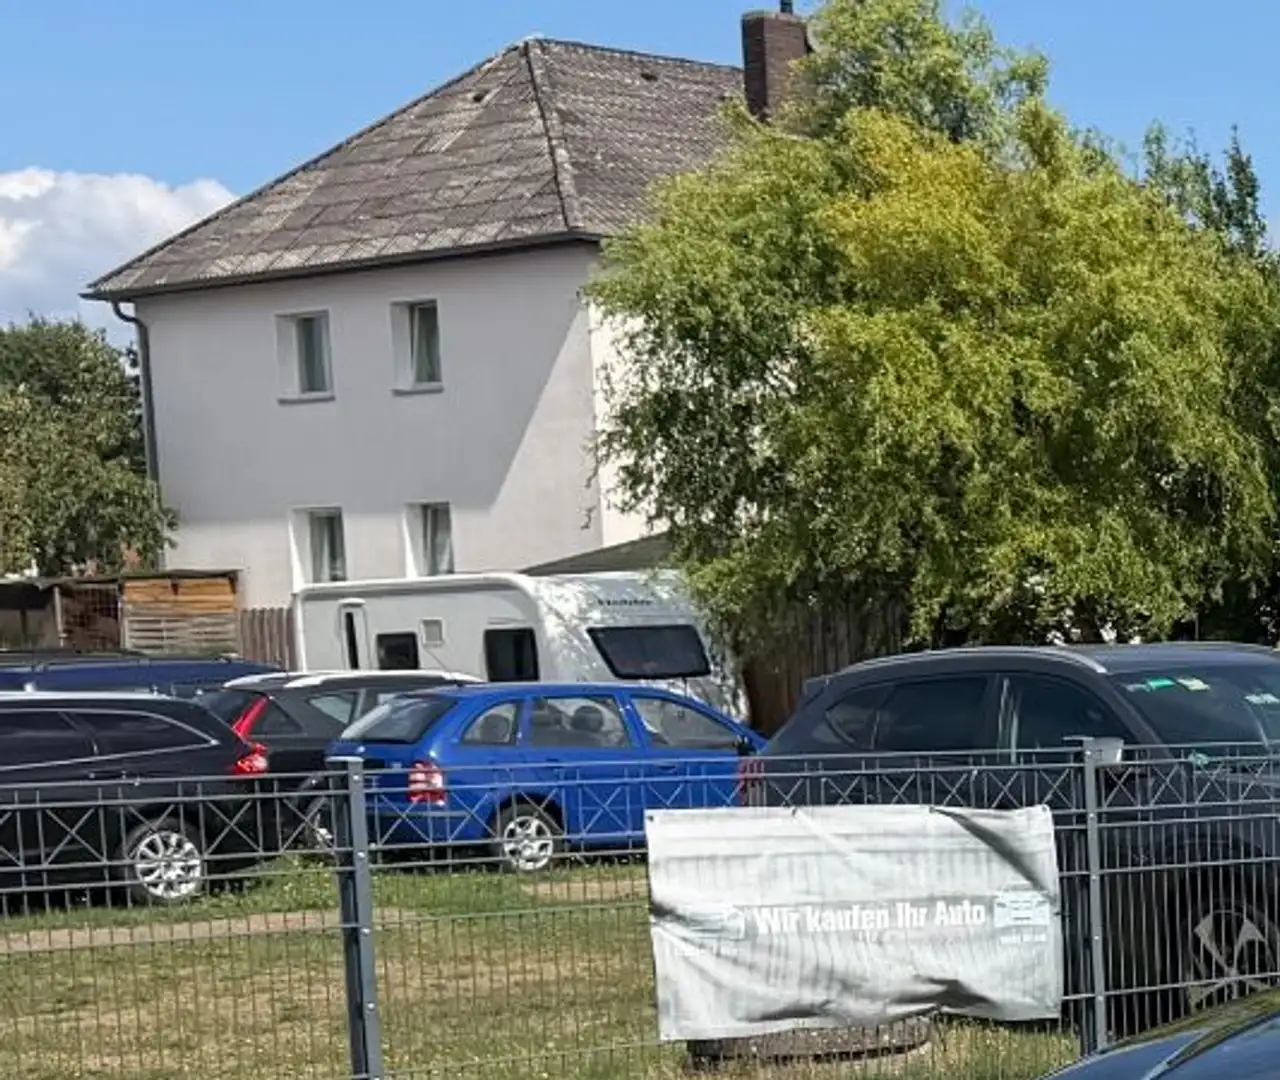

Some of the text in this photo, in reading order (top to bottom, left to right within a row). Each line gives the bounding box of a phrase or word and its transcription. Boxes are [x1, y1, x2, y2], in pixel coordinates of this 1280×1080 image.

[754, 906, 799, 935] Wir
[896, 901, 928, 928] Ihr
[934, 899, 986, 927] Auto
